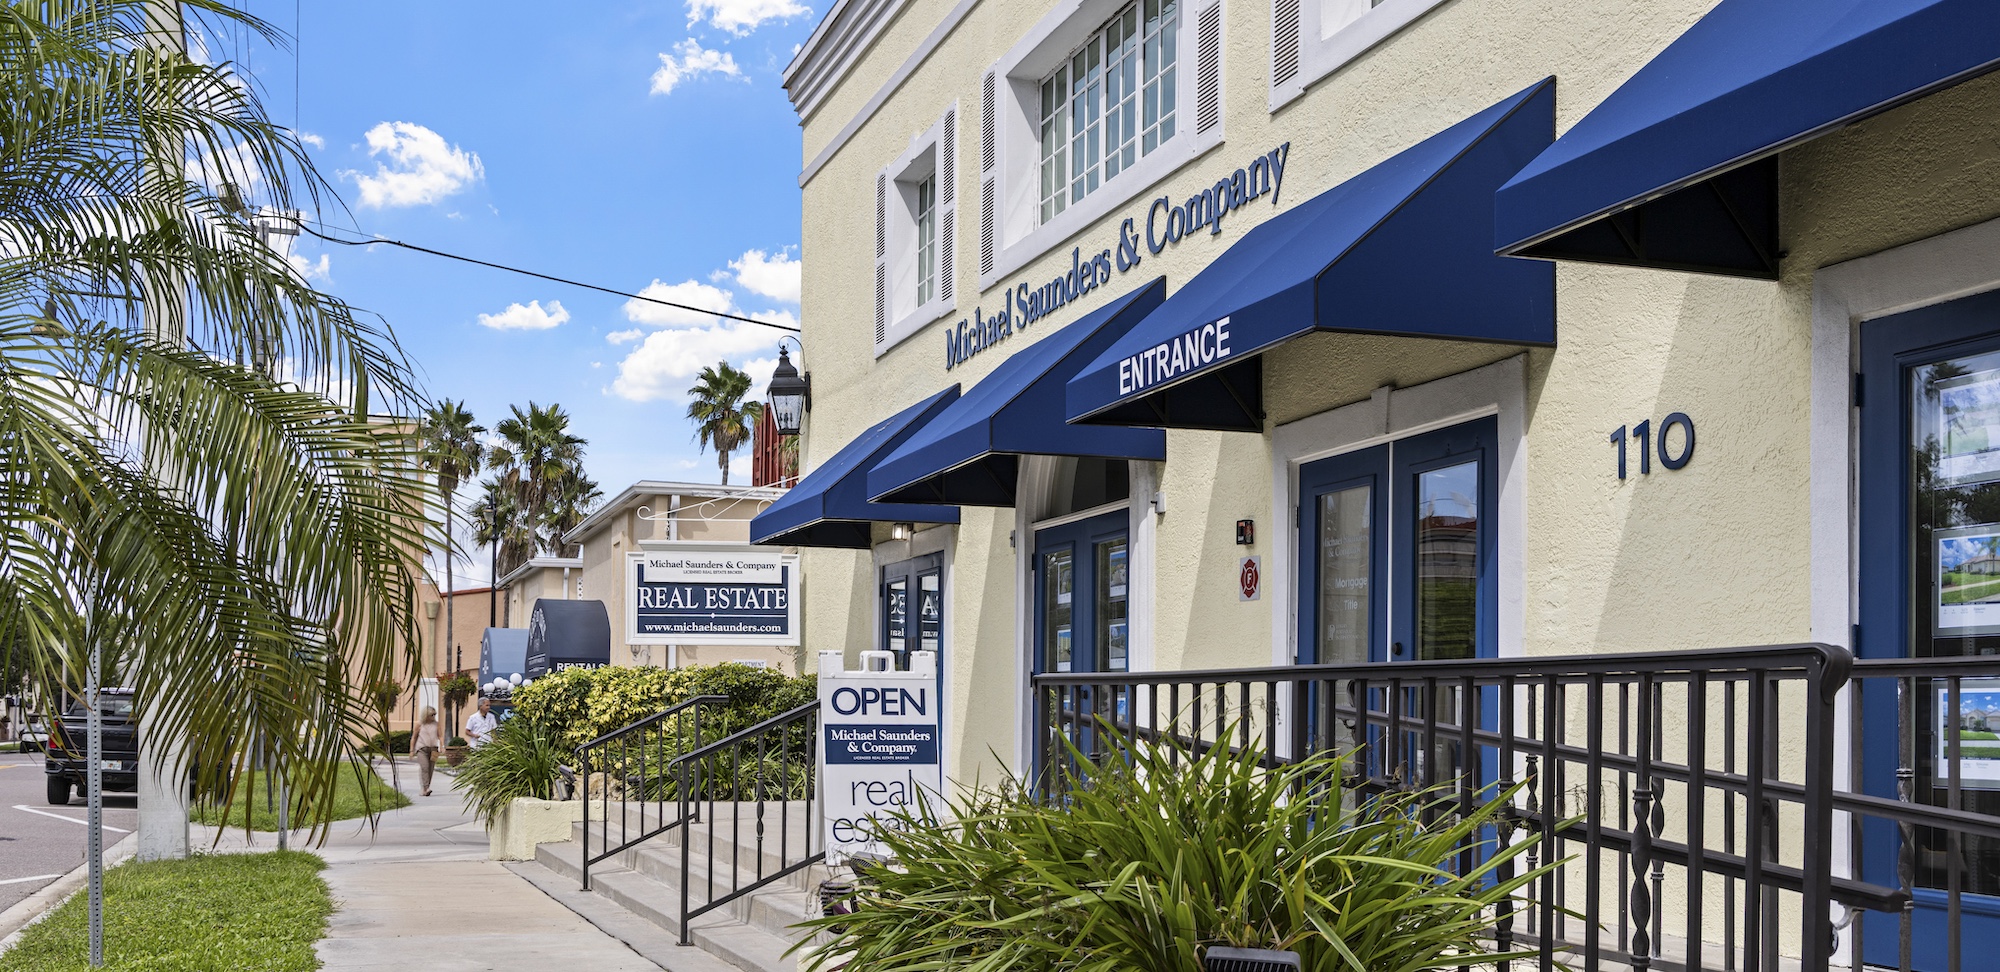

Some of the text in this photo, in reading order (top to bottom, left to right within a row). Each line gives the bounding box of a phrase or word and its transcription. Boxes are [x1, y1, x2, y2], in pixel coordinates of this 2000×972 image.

[945, 141, 1290, 370] Michael Saunders & Company
[1118, 316, 1231, 396] ENTRANCE
[1610, 411, 1695, 480] 110
[649, 560, 776, 571] Michael Saunders & Company
[1335, 577, 1368, 589] Mortgage
[638, 586, 788, 610] REAL ESTATE
[644, 622, 781, 632] www.michaelsaunders.com
[831, 687, 926, 716] OPEN
[831, 729, 931, 741] Michael Saunders
[847, 742, 859, 753] &
[852, 769, 912, 806] real
